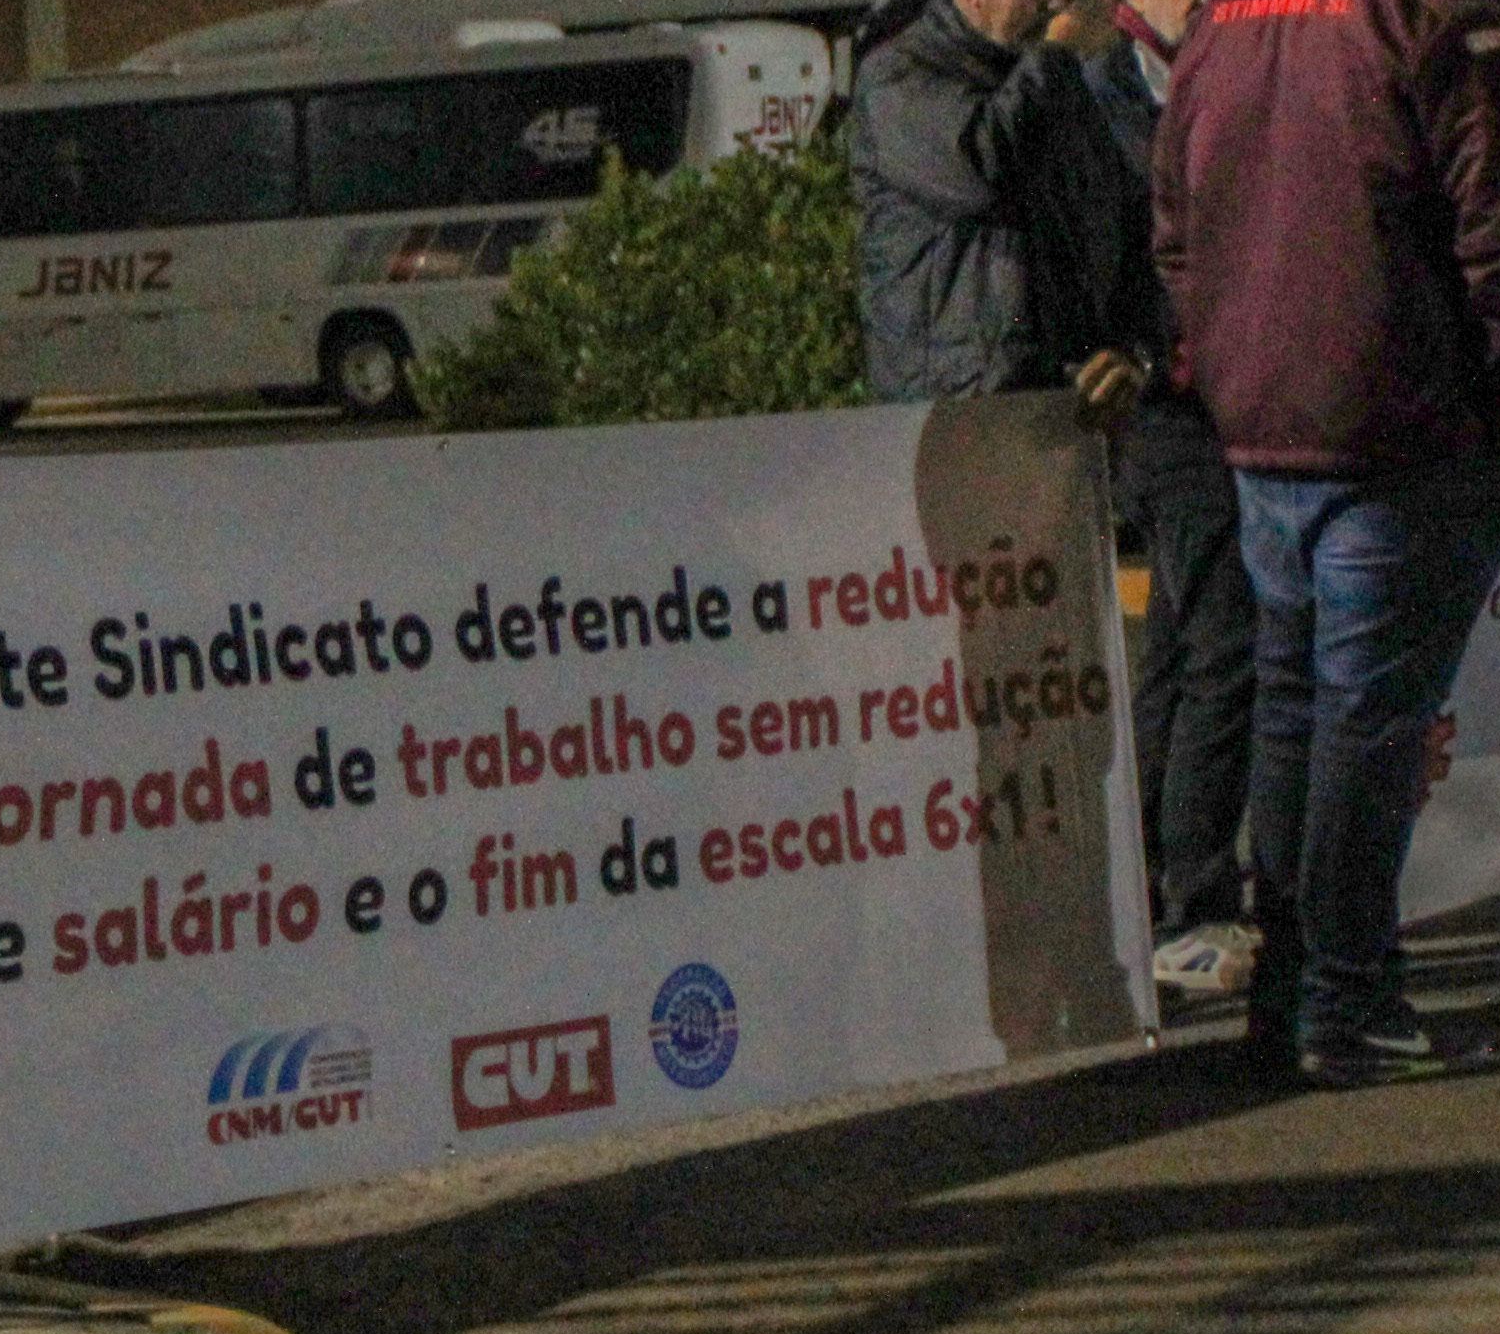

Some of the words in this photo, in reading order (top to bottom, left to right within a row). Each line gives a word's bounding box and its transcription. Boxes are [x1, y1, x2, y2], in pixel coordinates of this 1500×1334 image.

[90, 599, 433, 702] Sindicato
[454, 566, 732, 663] defende
[751, 579, 788, 632] a
[807, 536, 1059, 629] redução
[295, 728, 376, 809] de
[399, 694, 696, 798] trabalho
[716, 692, 840, 763] sem
[860, 643, 1112, 744] redução
[53, 864, 320, 973] salário
[344, 875, 385, 933] e
[408, 867, 449, 925] o
[468, 833, 579, 918] fim
[600, 817, 679, 896] da
[699, 789, 906, 885] escala
[458, 1021, 604, 1111] CUT
